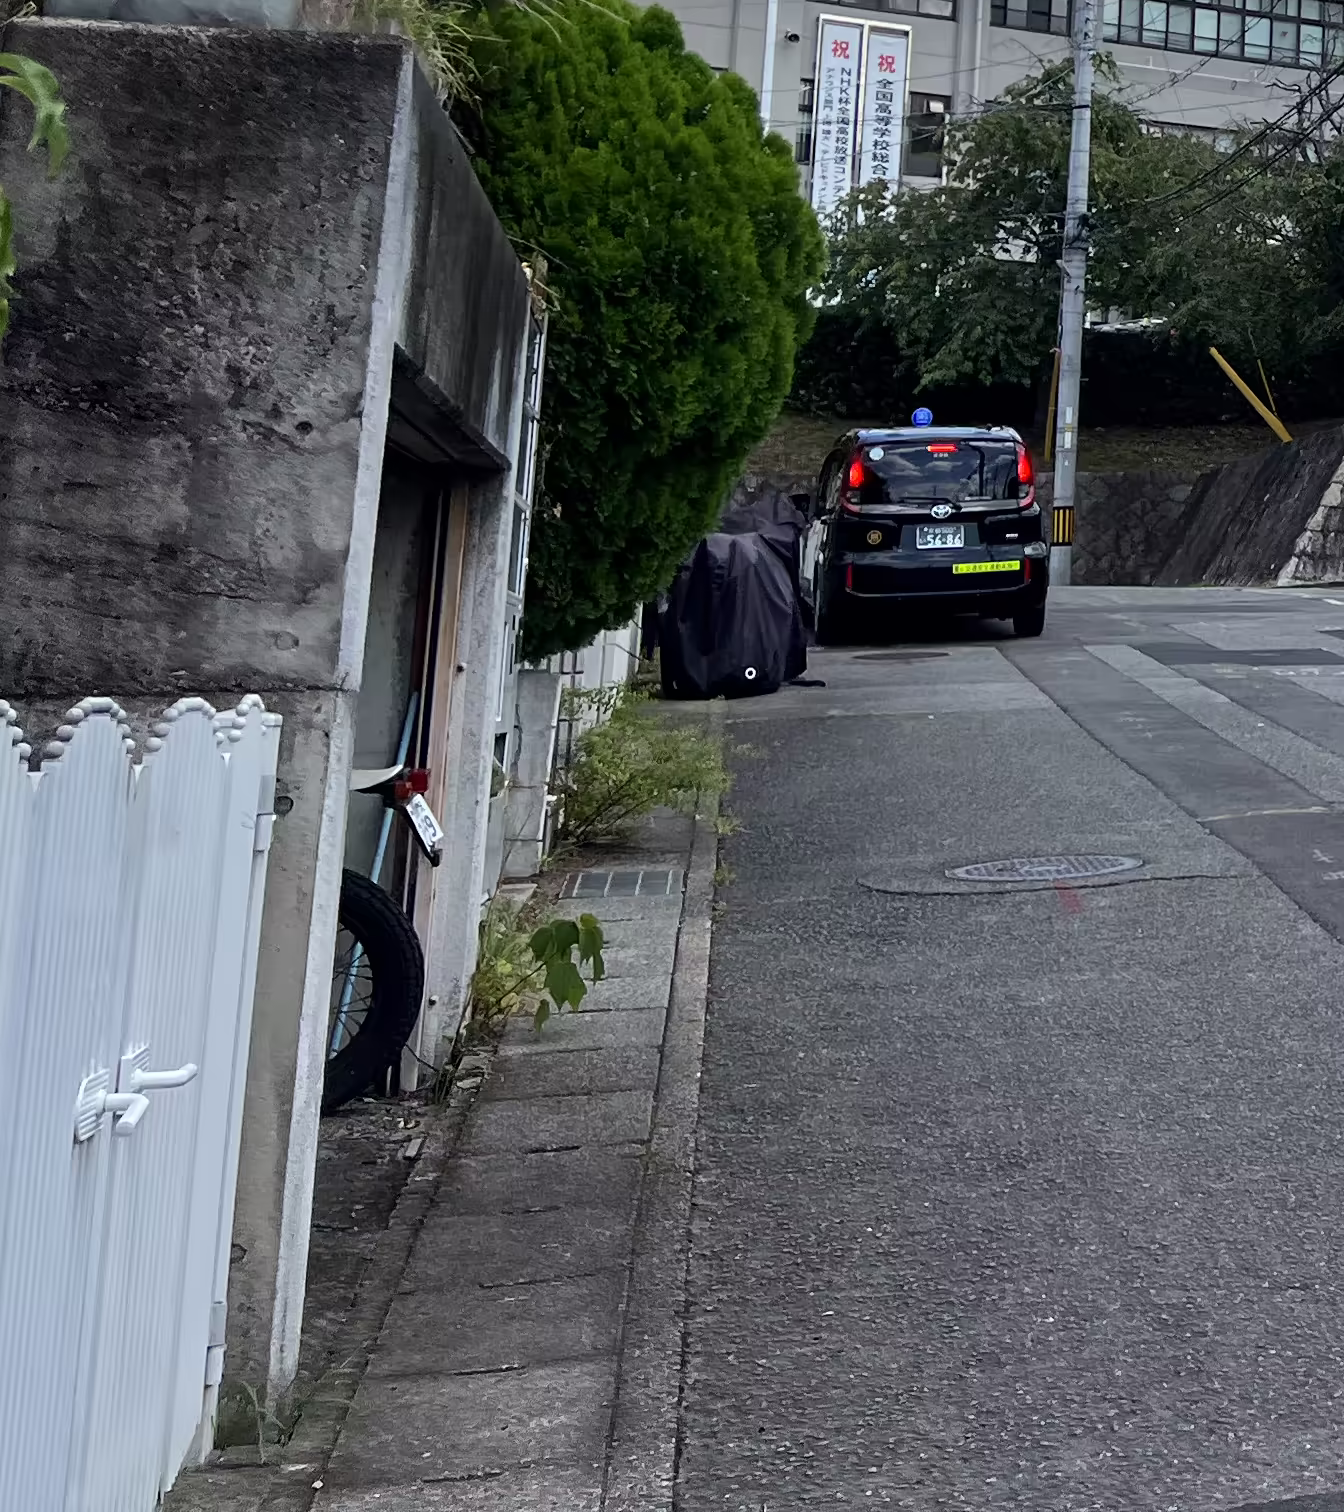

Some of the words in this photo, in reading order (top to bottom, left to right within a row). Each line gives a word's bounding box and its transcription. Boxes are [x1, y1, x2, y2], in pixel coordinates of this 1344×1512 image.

[831, 39, 850, 60] 祝
[877, 52, 896, 73] 祝
[871, 78, 894, 180] 全国高等学校総合
